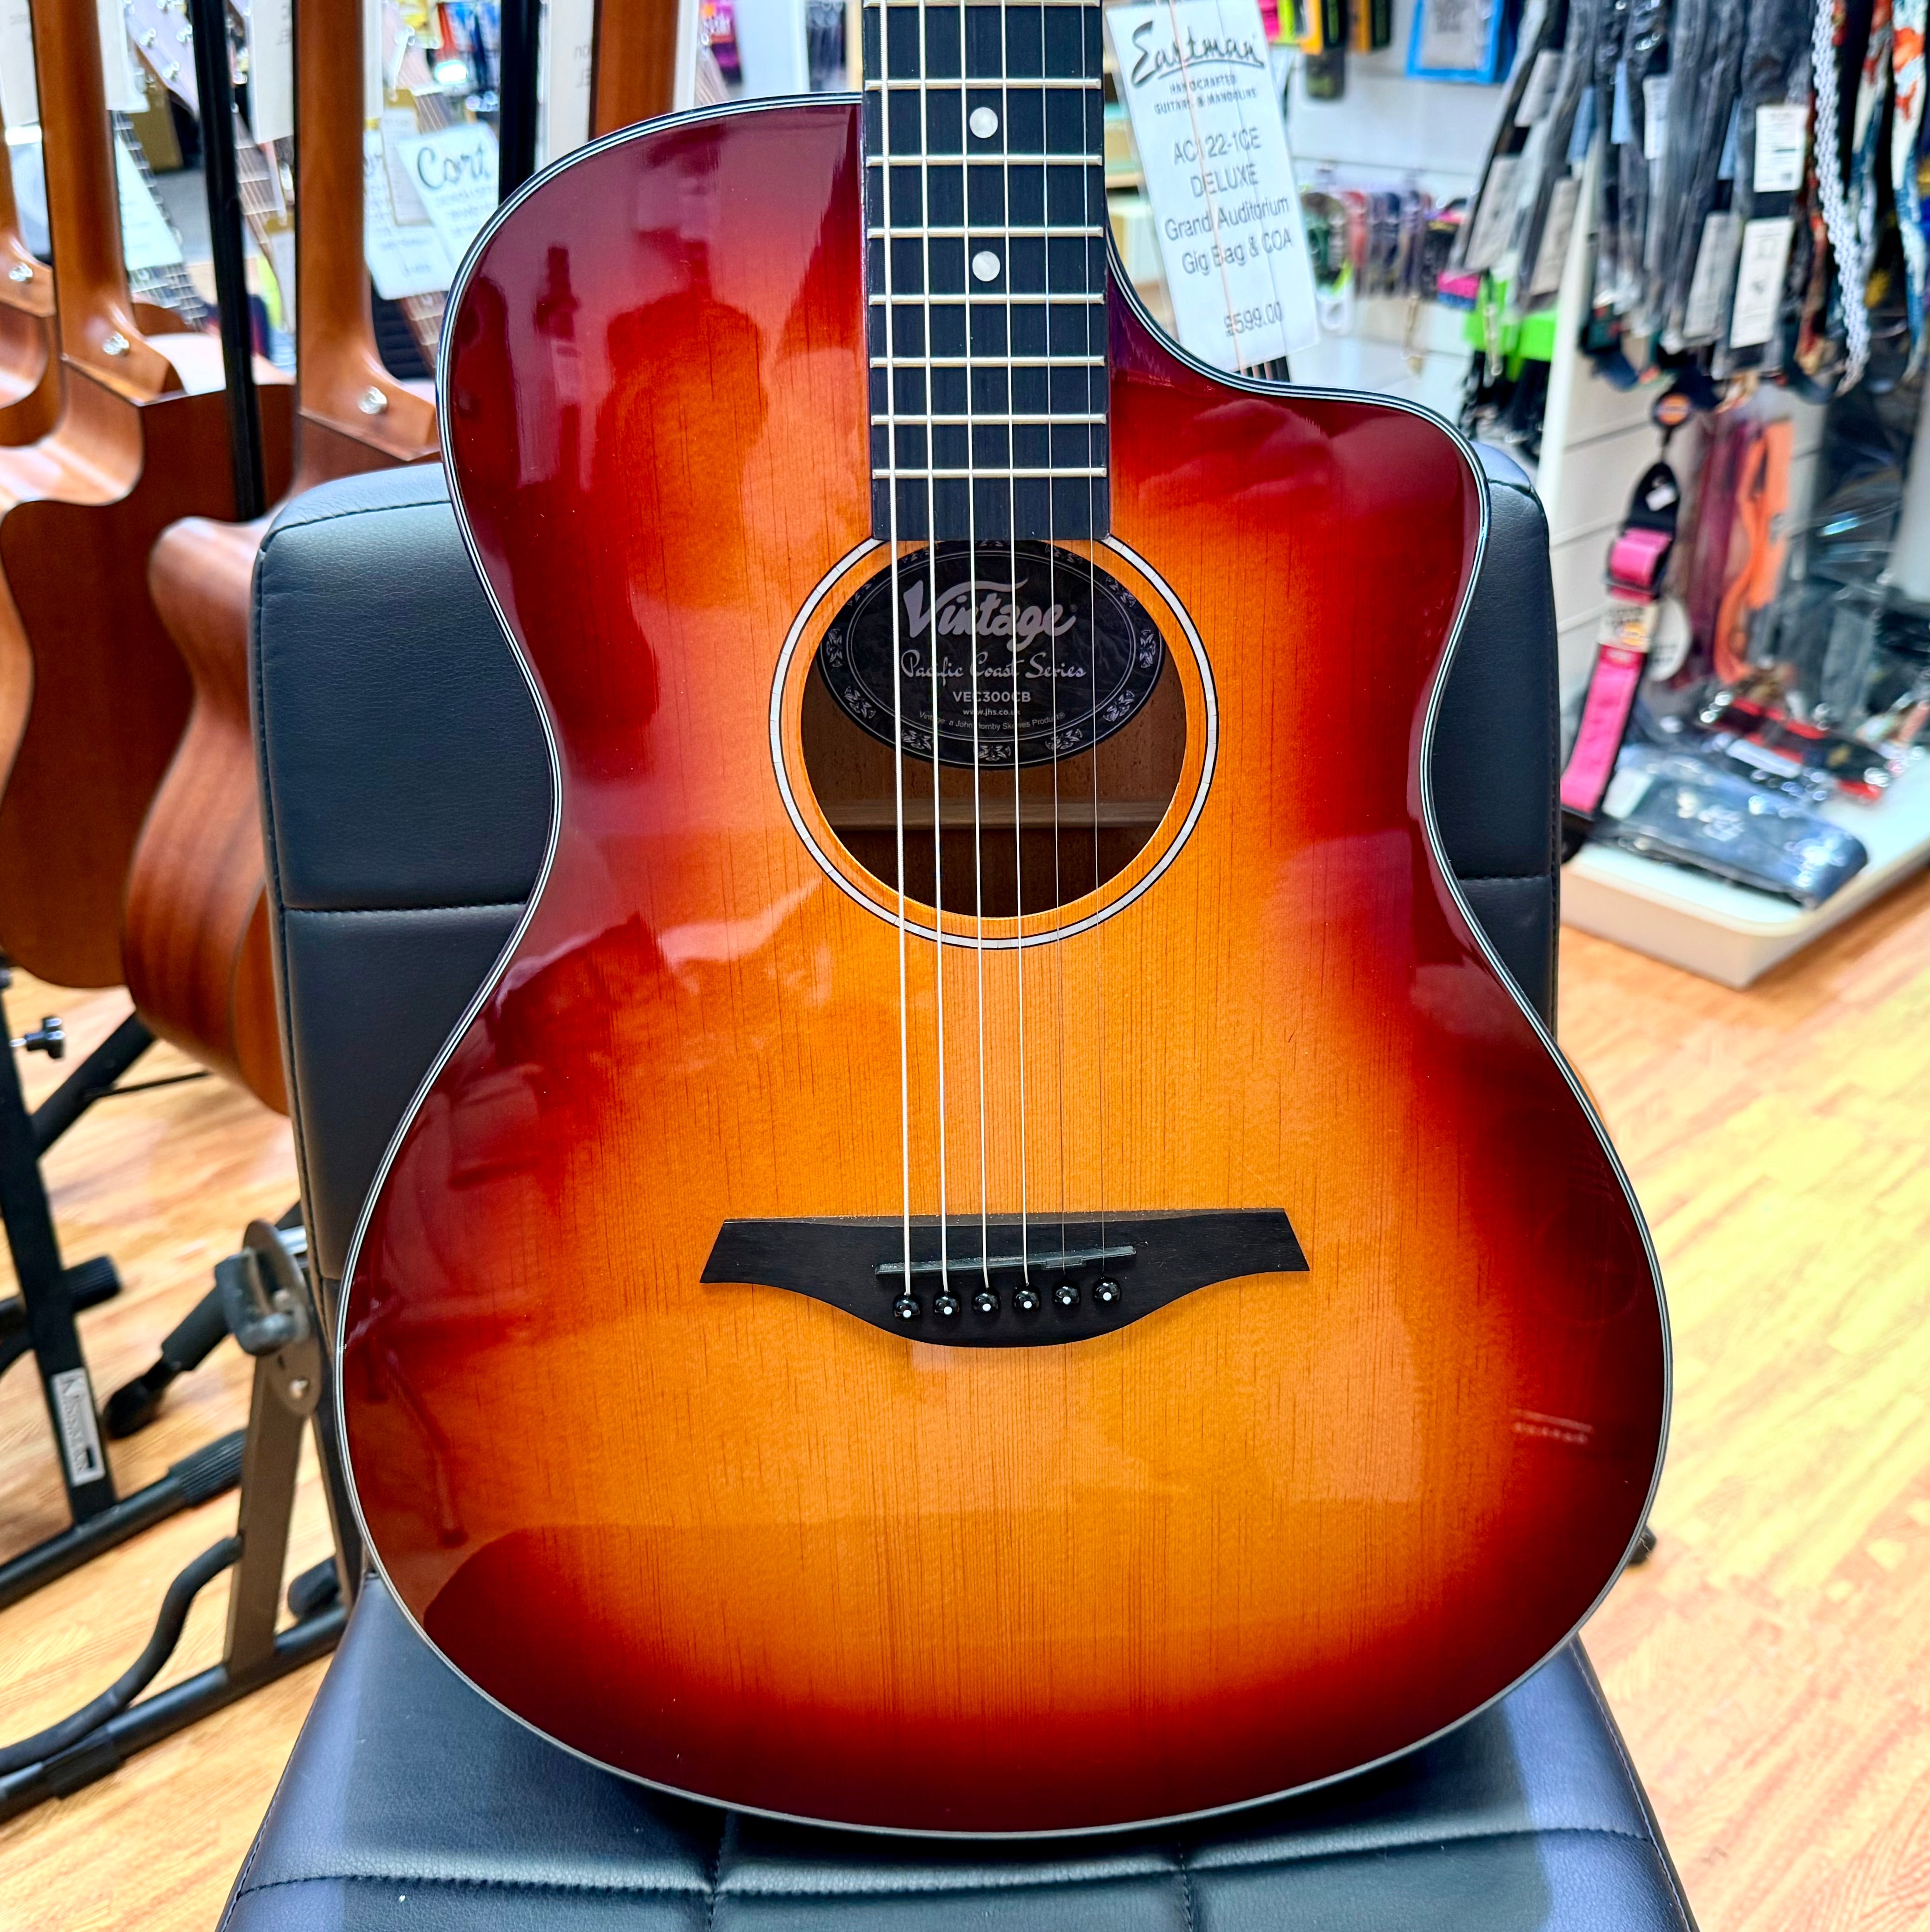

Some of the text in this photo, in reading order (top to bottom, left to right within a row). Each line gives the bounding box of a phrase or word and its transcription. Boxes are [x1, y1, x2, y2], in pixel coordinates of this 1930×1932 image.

[1131, 20, 1265, 88] Eastman
[417, 140, 492, 191] Cort
[1190, 163, 1259, 198] DELUXE
[1164, 197, 1289, 241] Grand Auditorium
[1182, 228, 1294, 276] Gig Bag & COA
[1025, 652, 1087, 679] Series
[955, 720, 973, 728] John
